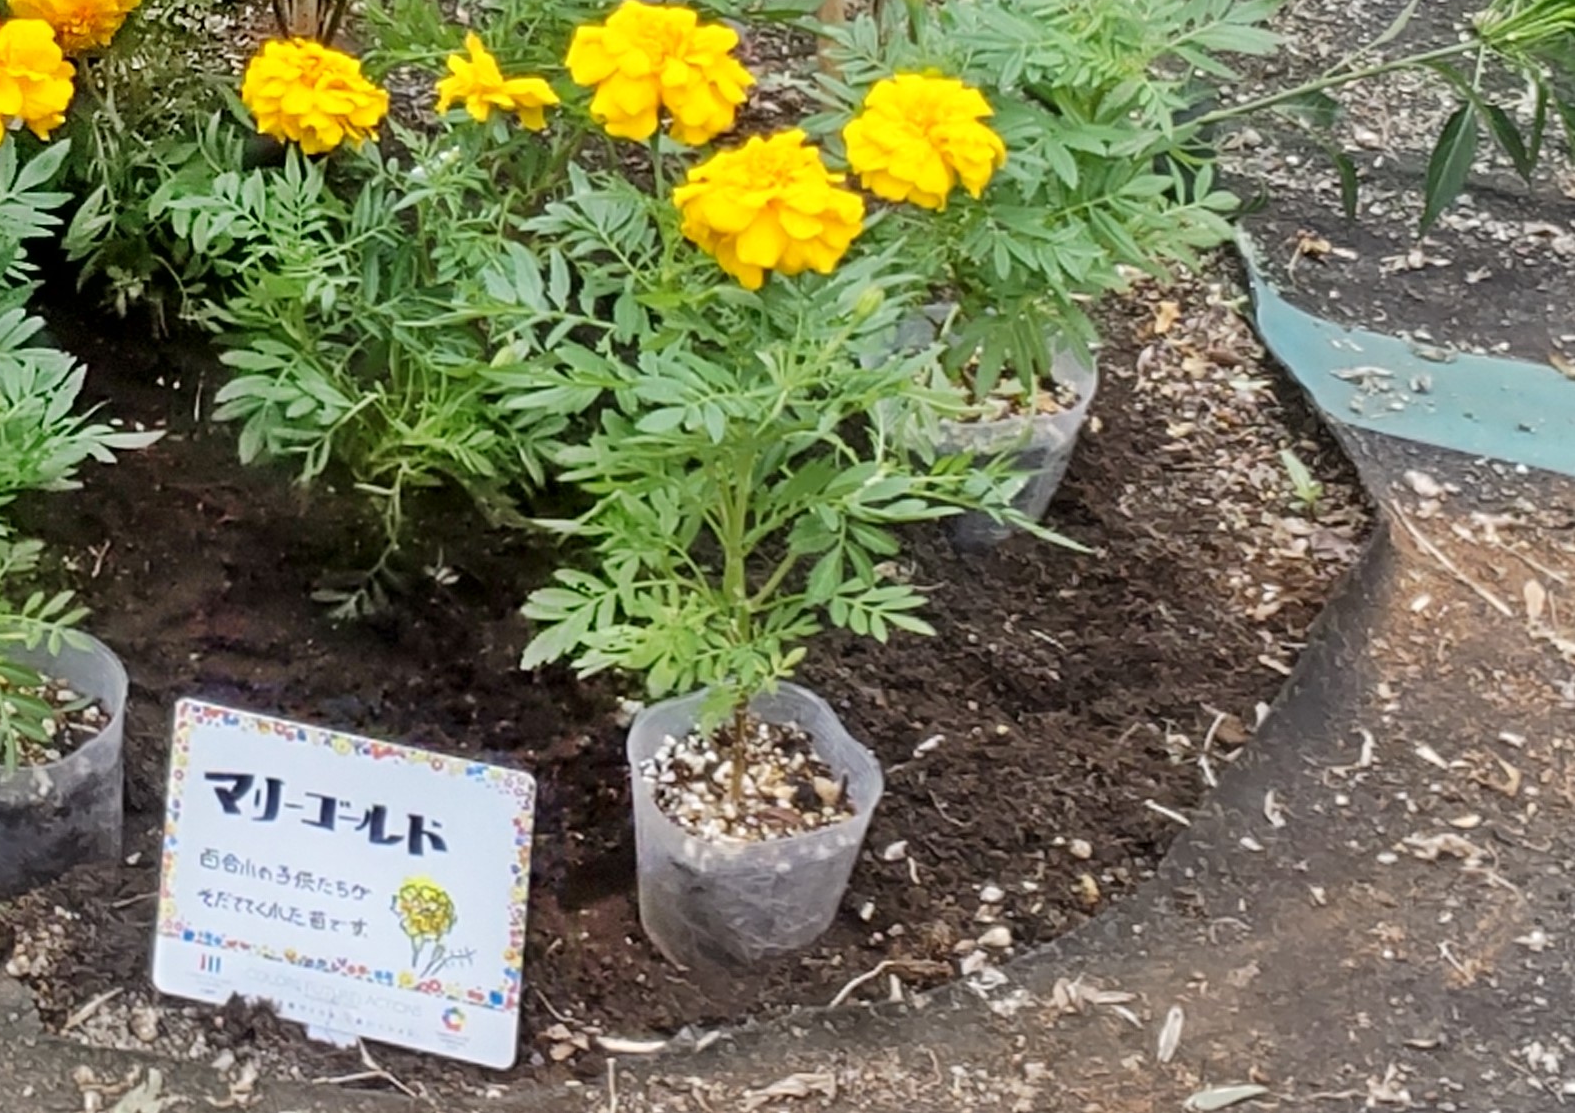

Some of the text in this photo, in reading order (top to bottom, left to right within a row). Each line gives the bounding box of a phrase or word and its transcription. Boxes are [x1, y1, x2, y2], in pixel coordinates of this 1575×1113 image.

[204, 771, 448, 857] マリーゴールド
